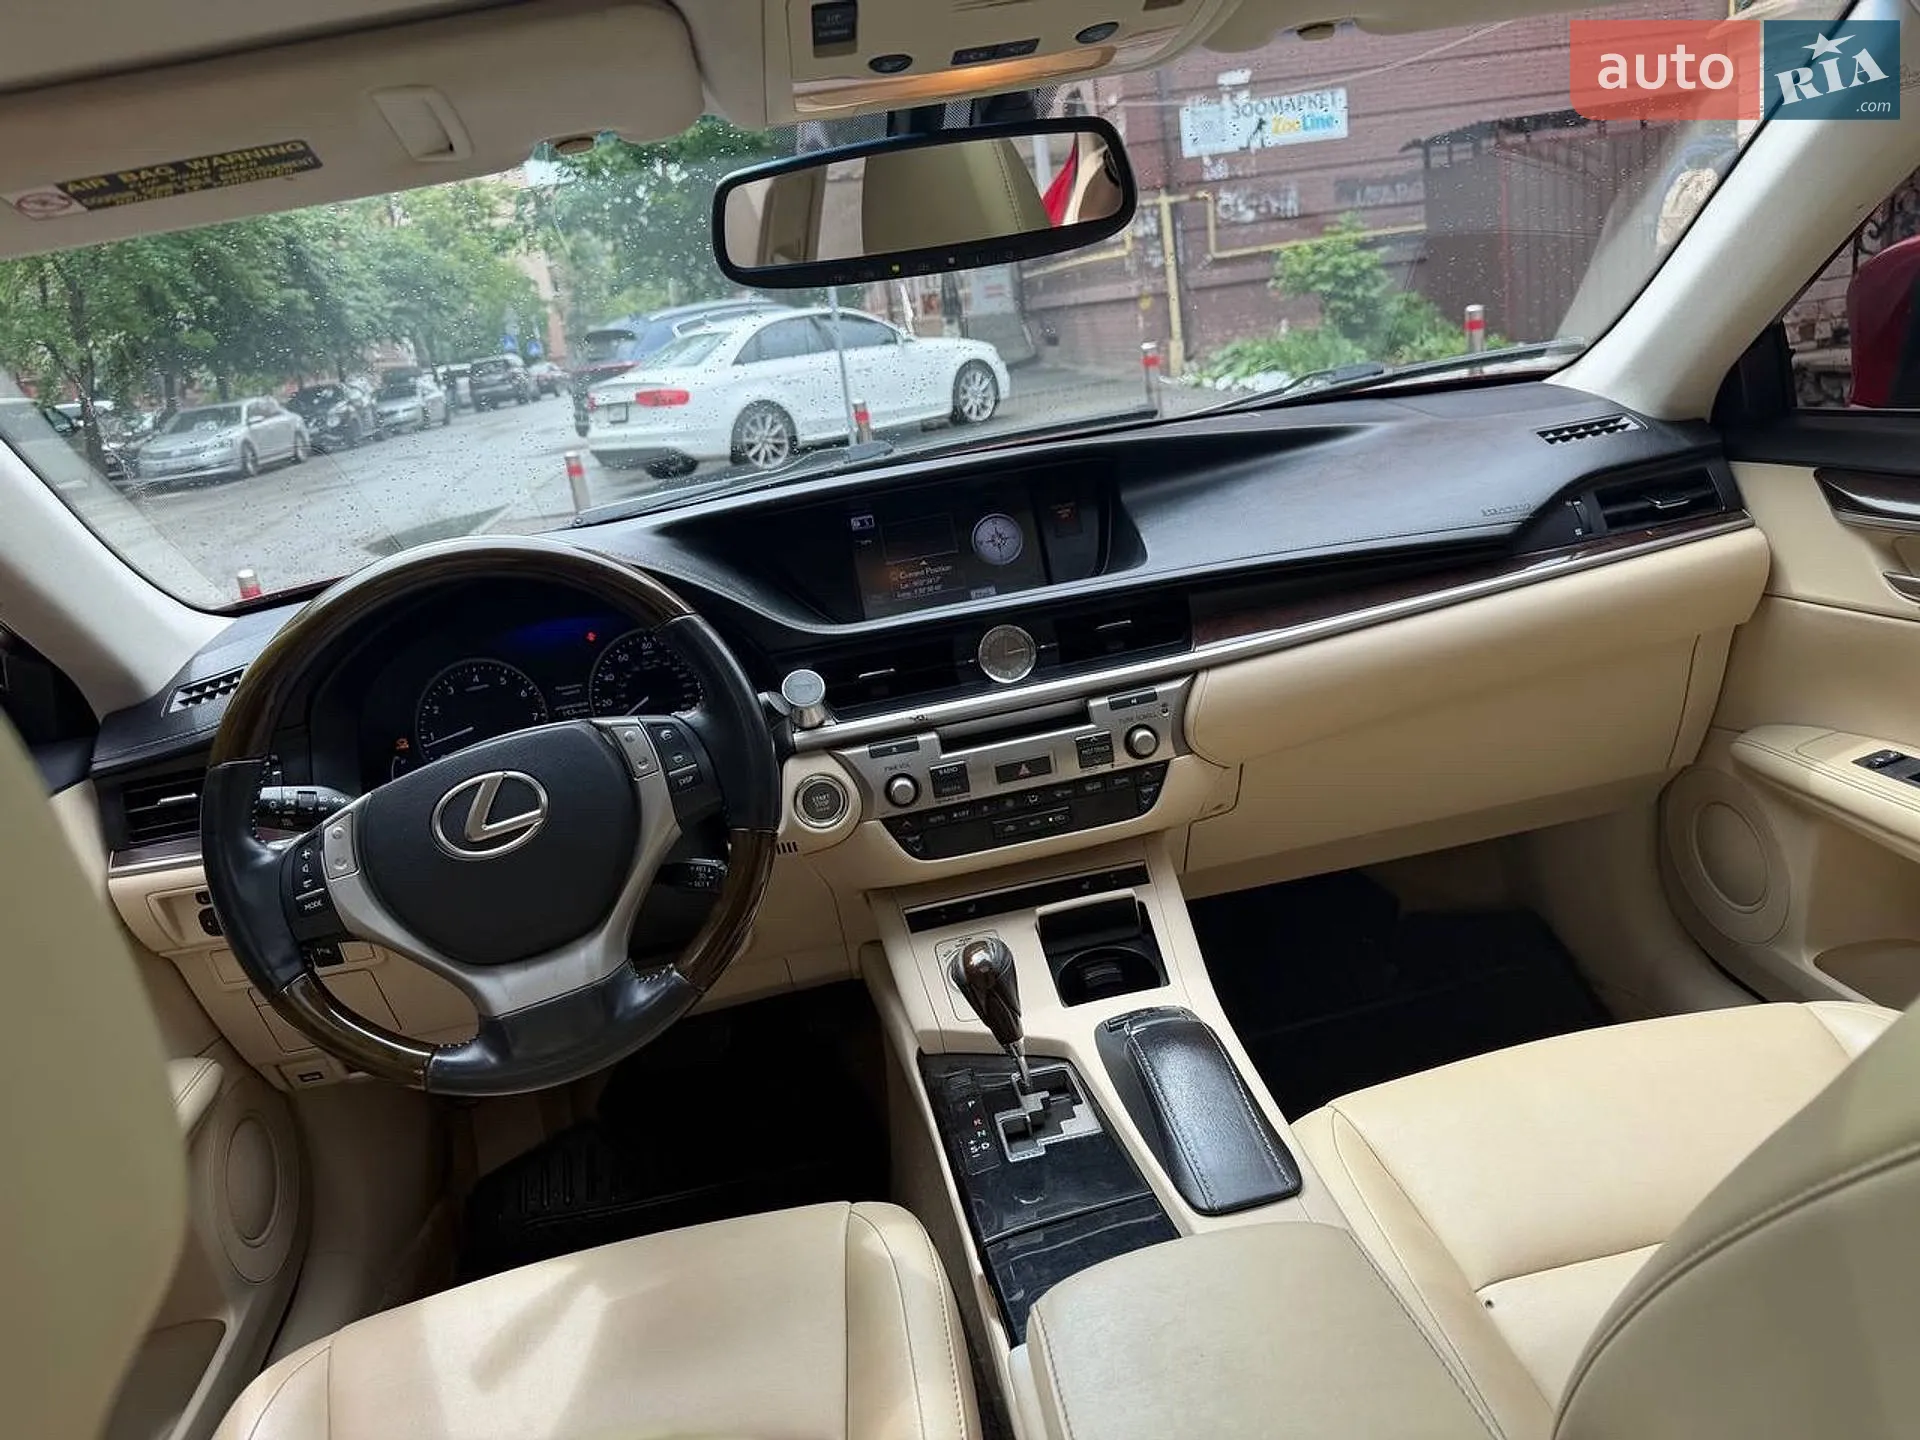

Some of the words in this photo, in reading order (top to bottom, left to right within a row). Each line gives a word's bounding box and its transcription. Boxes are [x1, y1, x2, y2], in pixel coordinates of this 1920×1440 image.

[66, 177, 110, 194] AIR
[118, 165, 177, 184] BAG
[186, 141, 306, 169] WARNING
